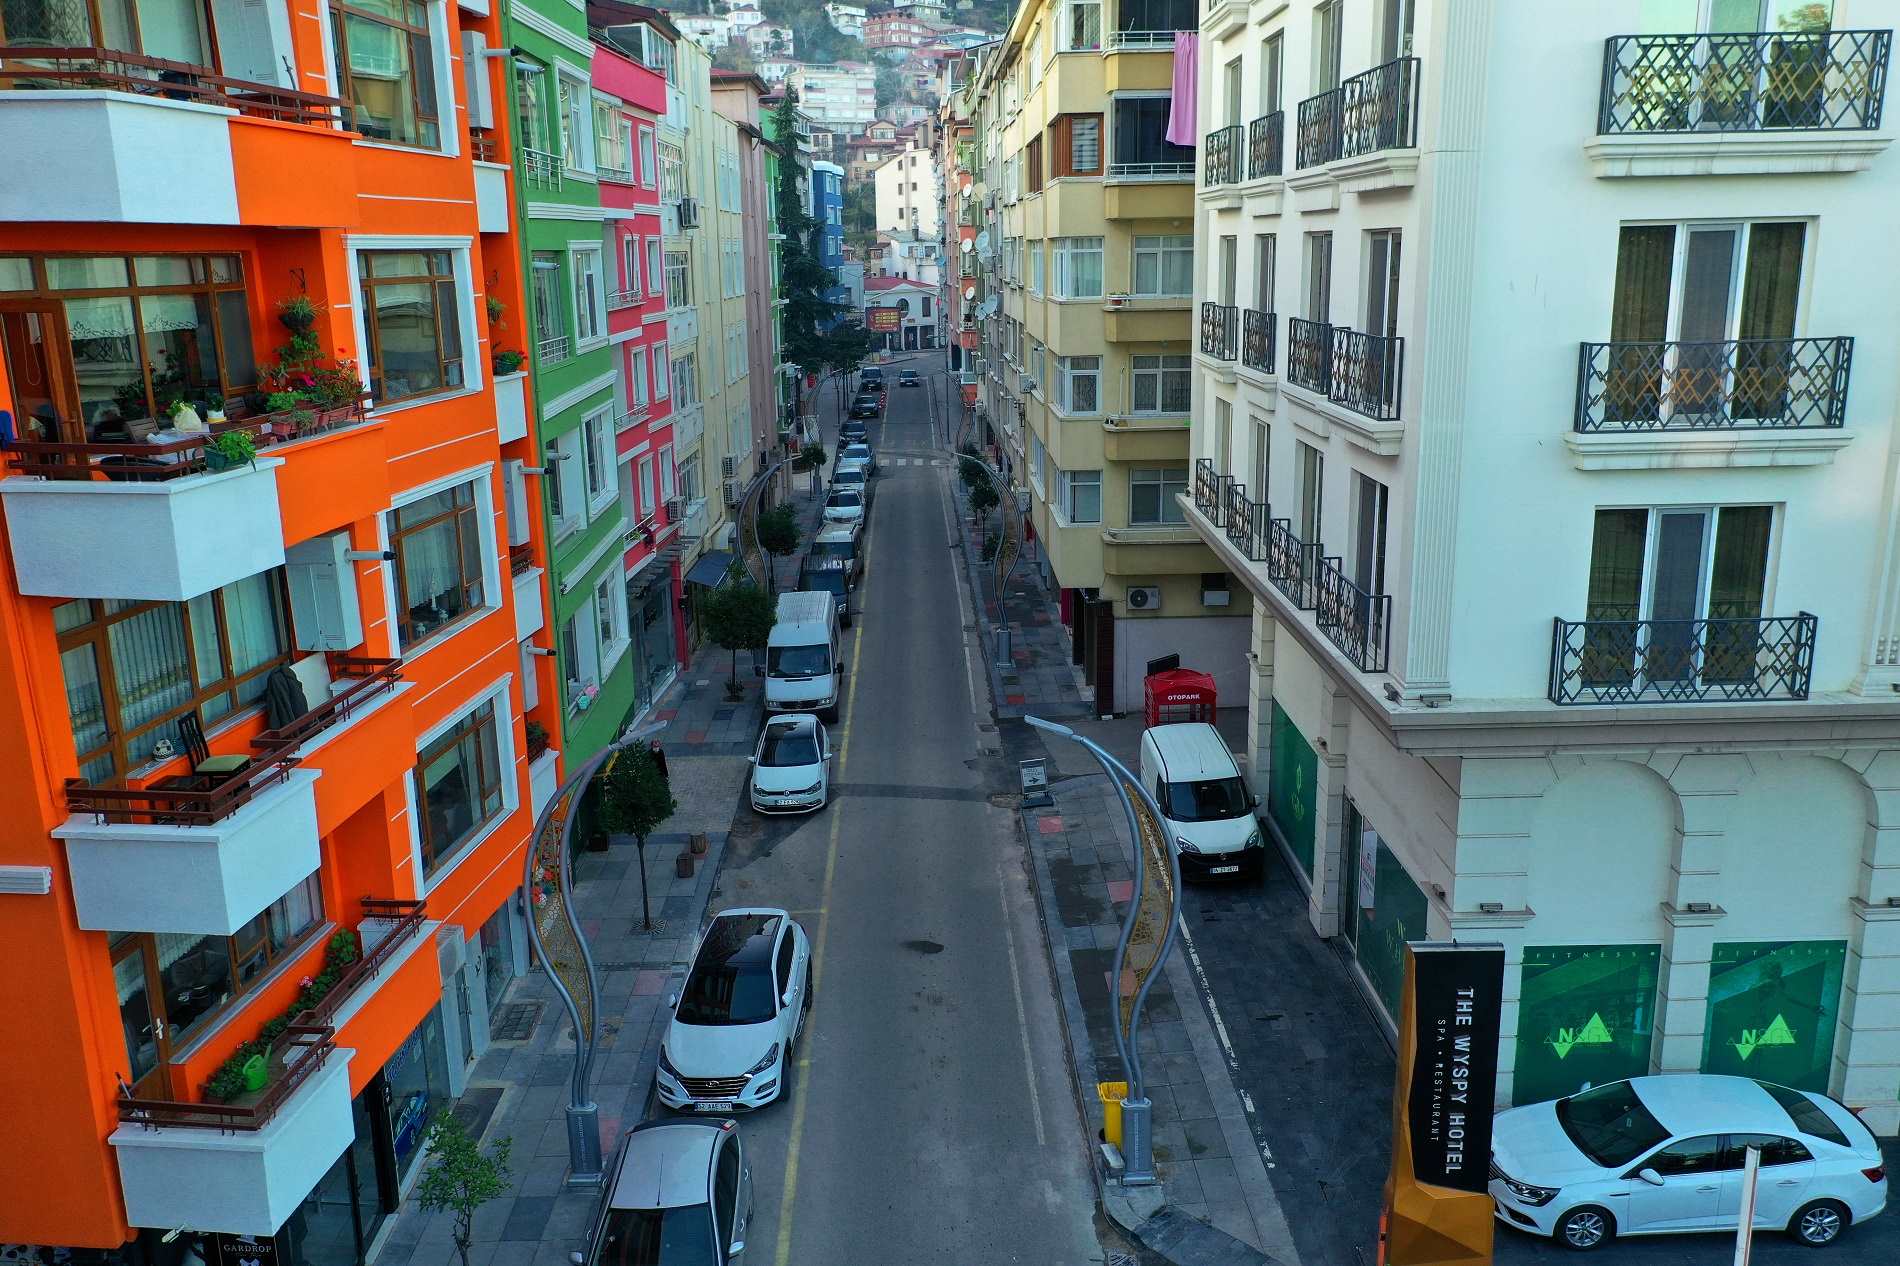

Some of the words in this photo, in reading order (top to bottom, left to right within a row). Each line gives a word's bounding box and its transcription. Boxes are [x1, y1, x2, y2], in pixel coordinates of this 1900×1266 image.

[1536, 951, 1637, 959] FITNESS
[1718, 949, 1830, 957] FITNESS
[1455, 987, 1474, 1026] THE
[1437, 1019, 1446, 1042] SPA
[1451, 1034, 1472, 1104] WYSPY
[1431, 1063, 1444, 1141] RESTAURANT
[1445, 1112, 1466, 1174] HOTEL
[224, 1245, 271, 1253] GARDROP
